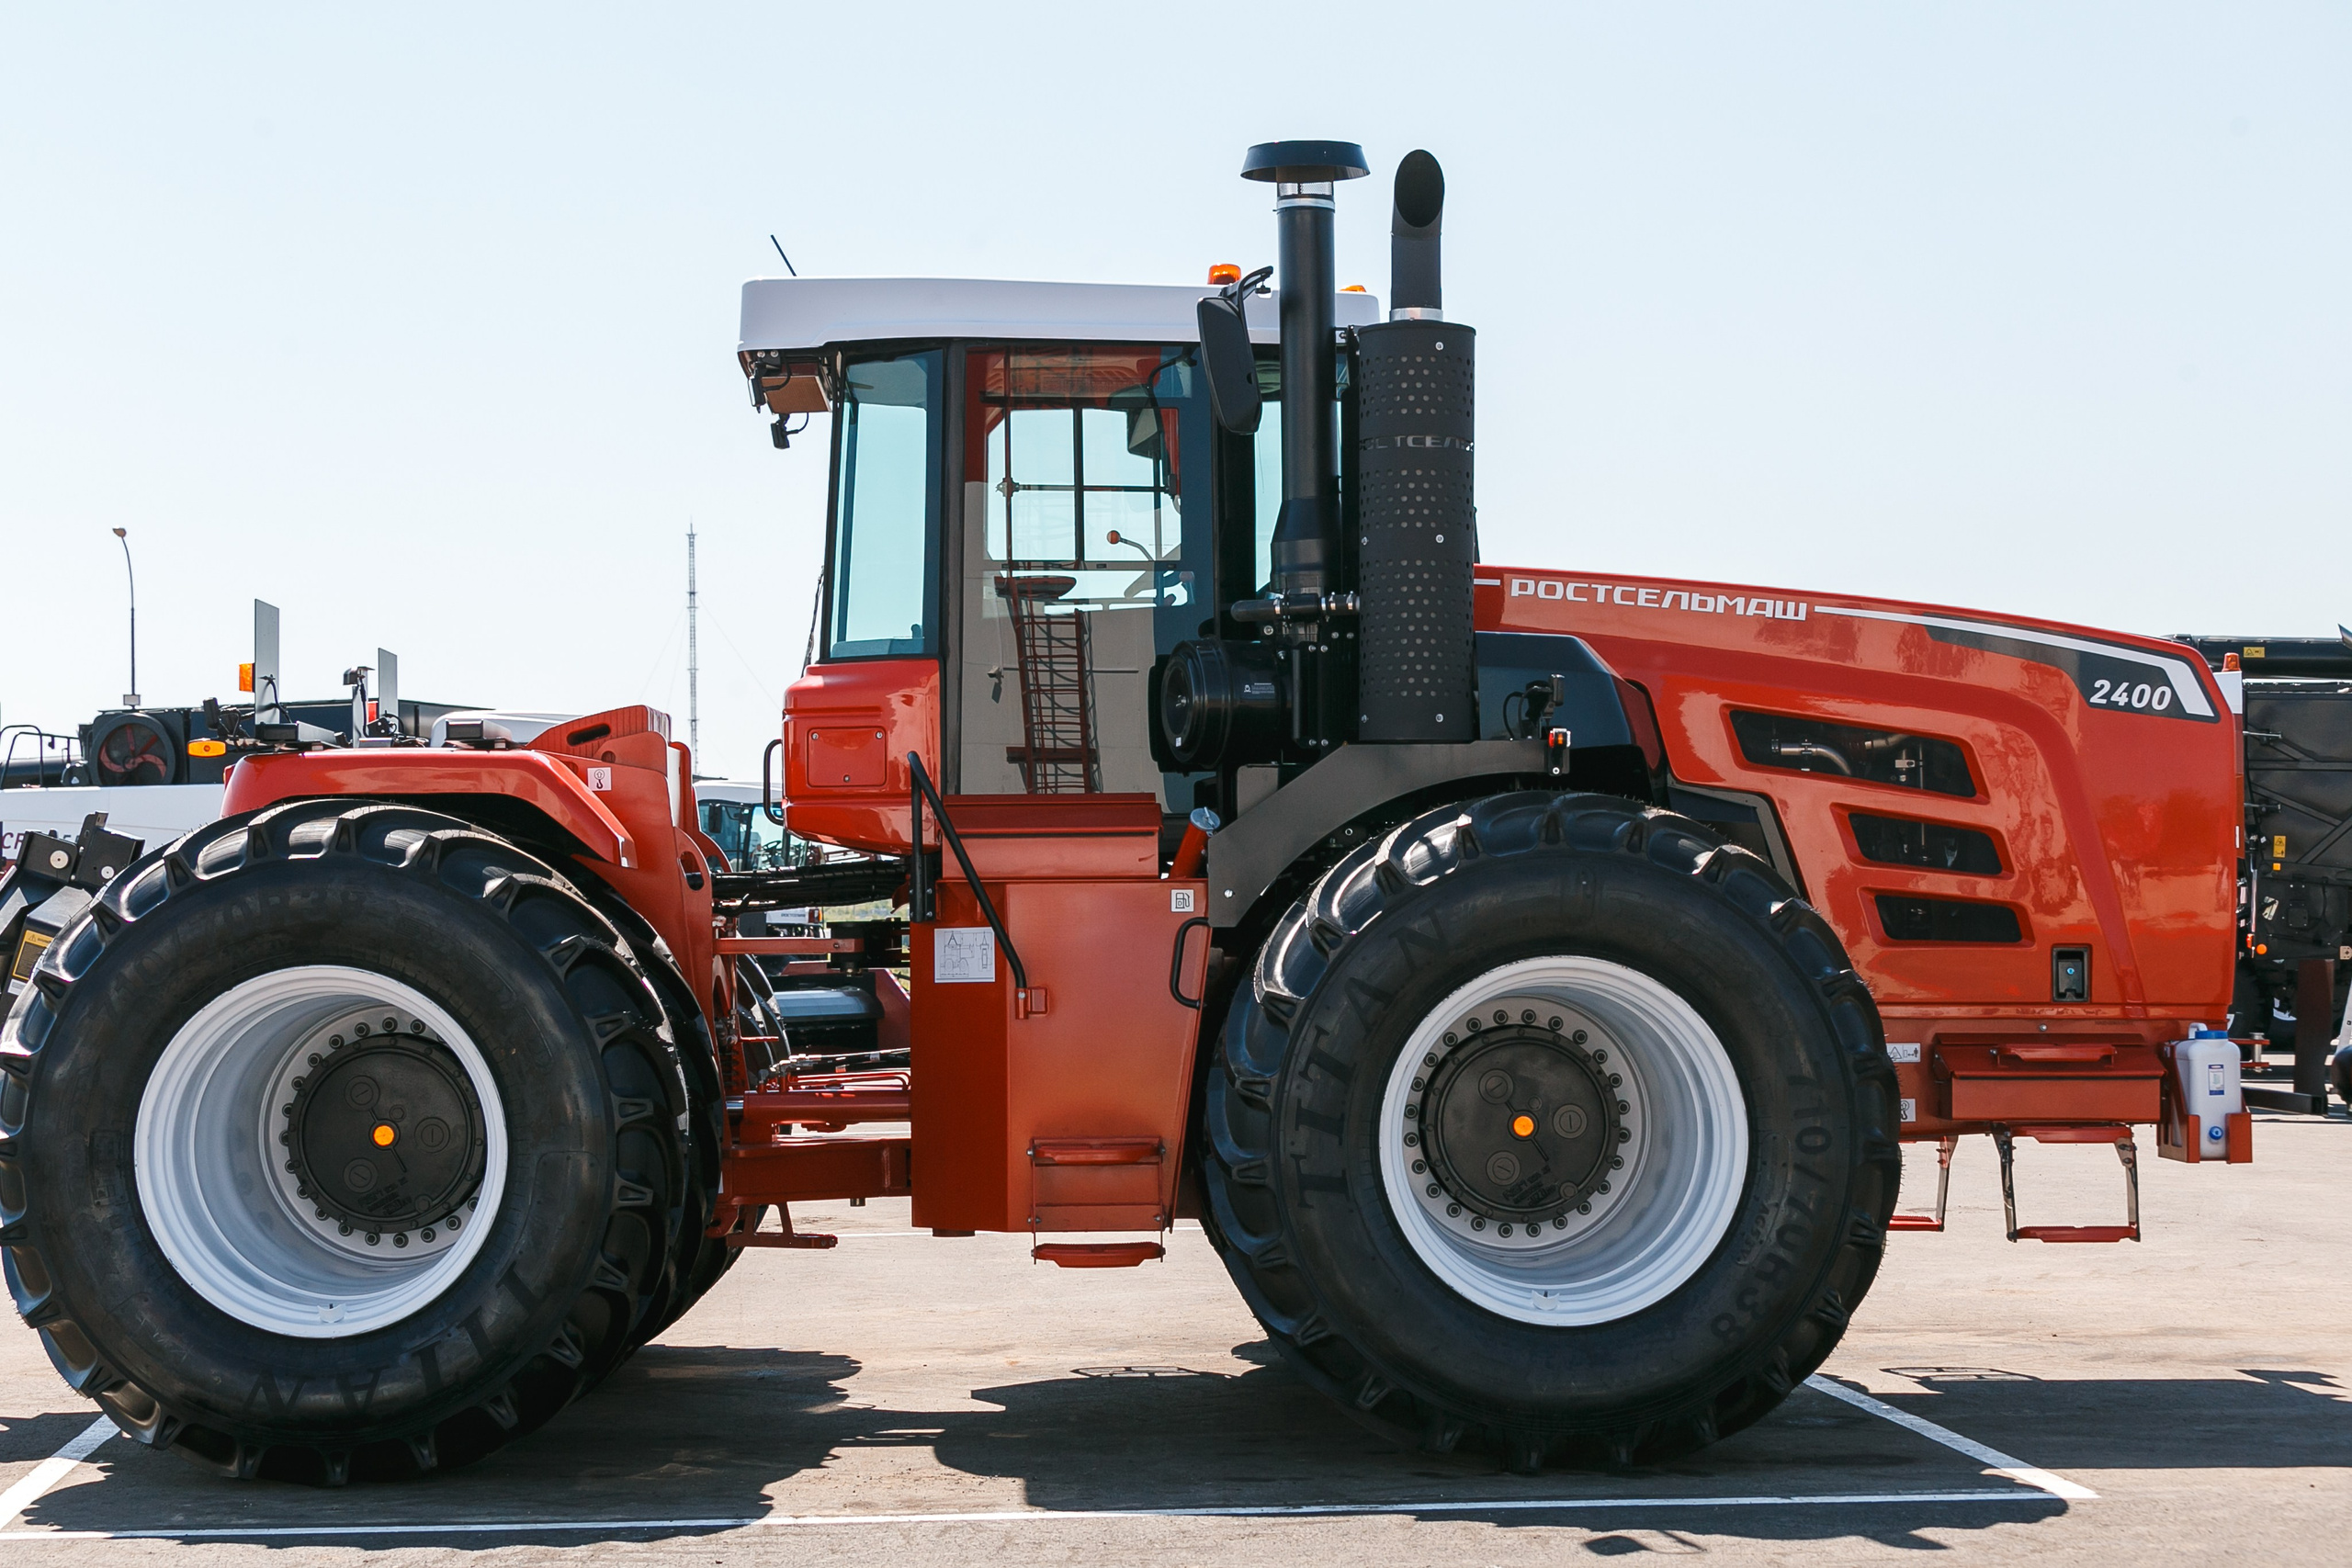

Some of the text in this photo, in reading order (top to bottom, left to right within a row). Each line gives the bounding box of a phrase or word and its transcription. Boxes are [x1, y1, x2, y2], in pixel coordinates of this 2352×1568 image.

[1510, 579, 1807, 621] РОСТСЕЛЬМАШ
[2089, 679, 2172, 711] 2400
[1290, 908, 1450, 1208] TITAN
[1710, 1060, 1833, 1345] 710/70R38
[239, 1260, 553, 1418] TITAN
